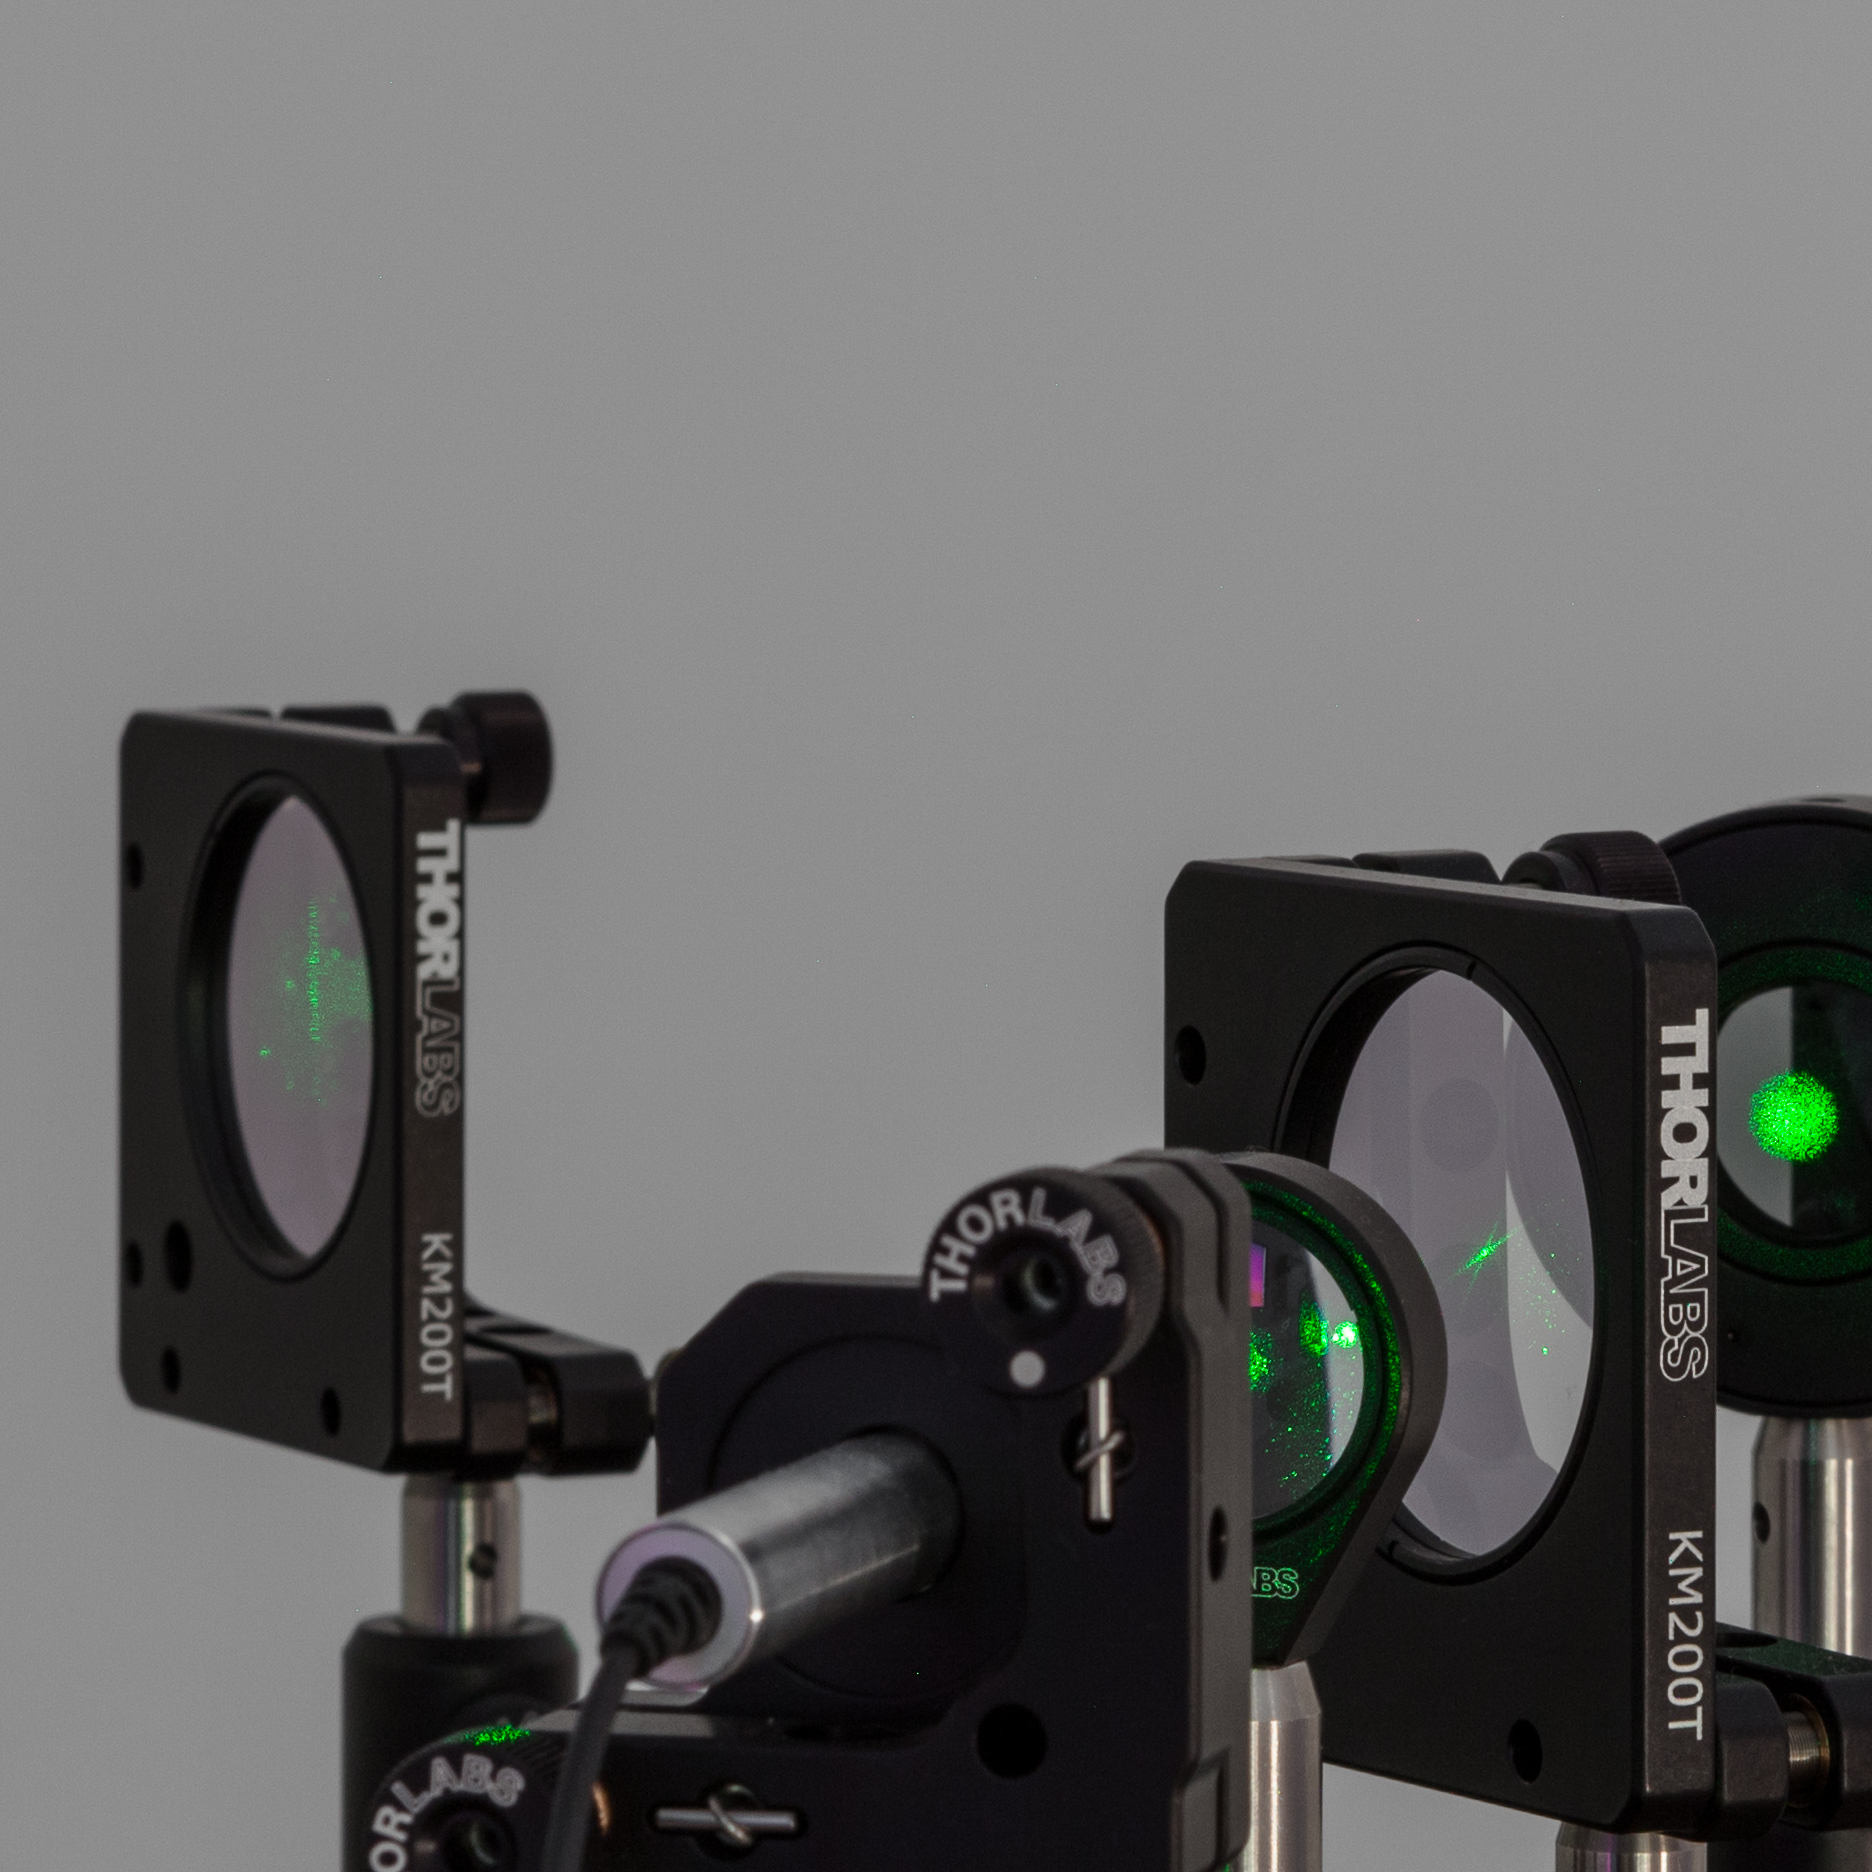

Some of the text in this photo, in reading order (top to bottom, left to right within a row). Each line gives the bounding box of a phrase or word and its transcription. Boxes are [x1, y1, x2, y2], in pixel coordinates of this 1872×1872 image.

[415, 818, 462, 1118] THORLABS
[928, 1186, 1127, 1307] THORLABS
[1659, 1008, 1710, 1383] THORLABS
[419, 1232, 454, 1401] KM200T
[1667, 1530, 1704, 1741] KM200T
